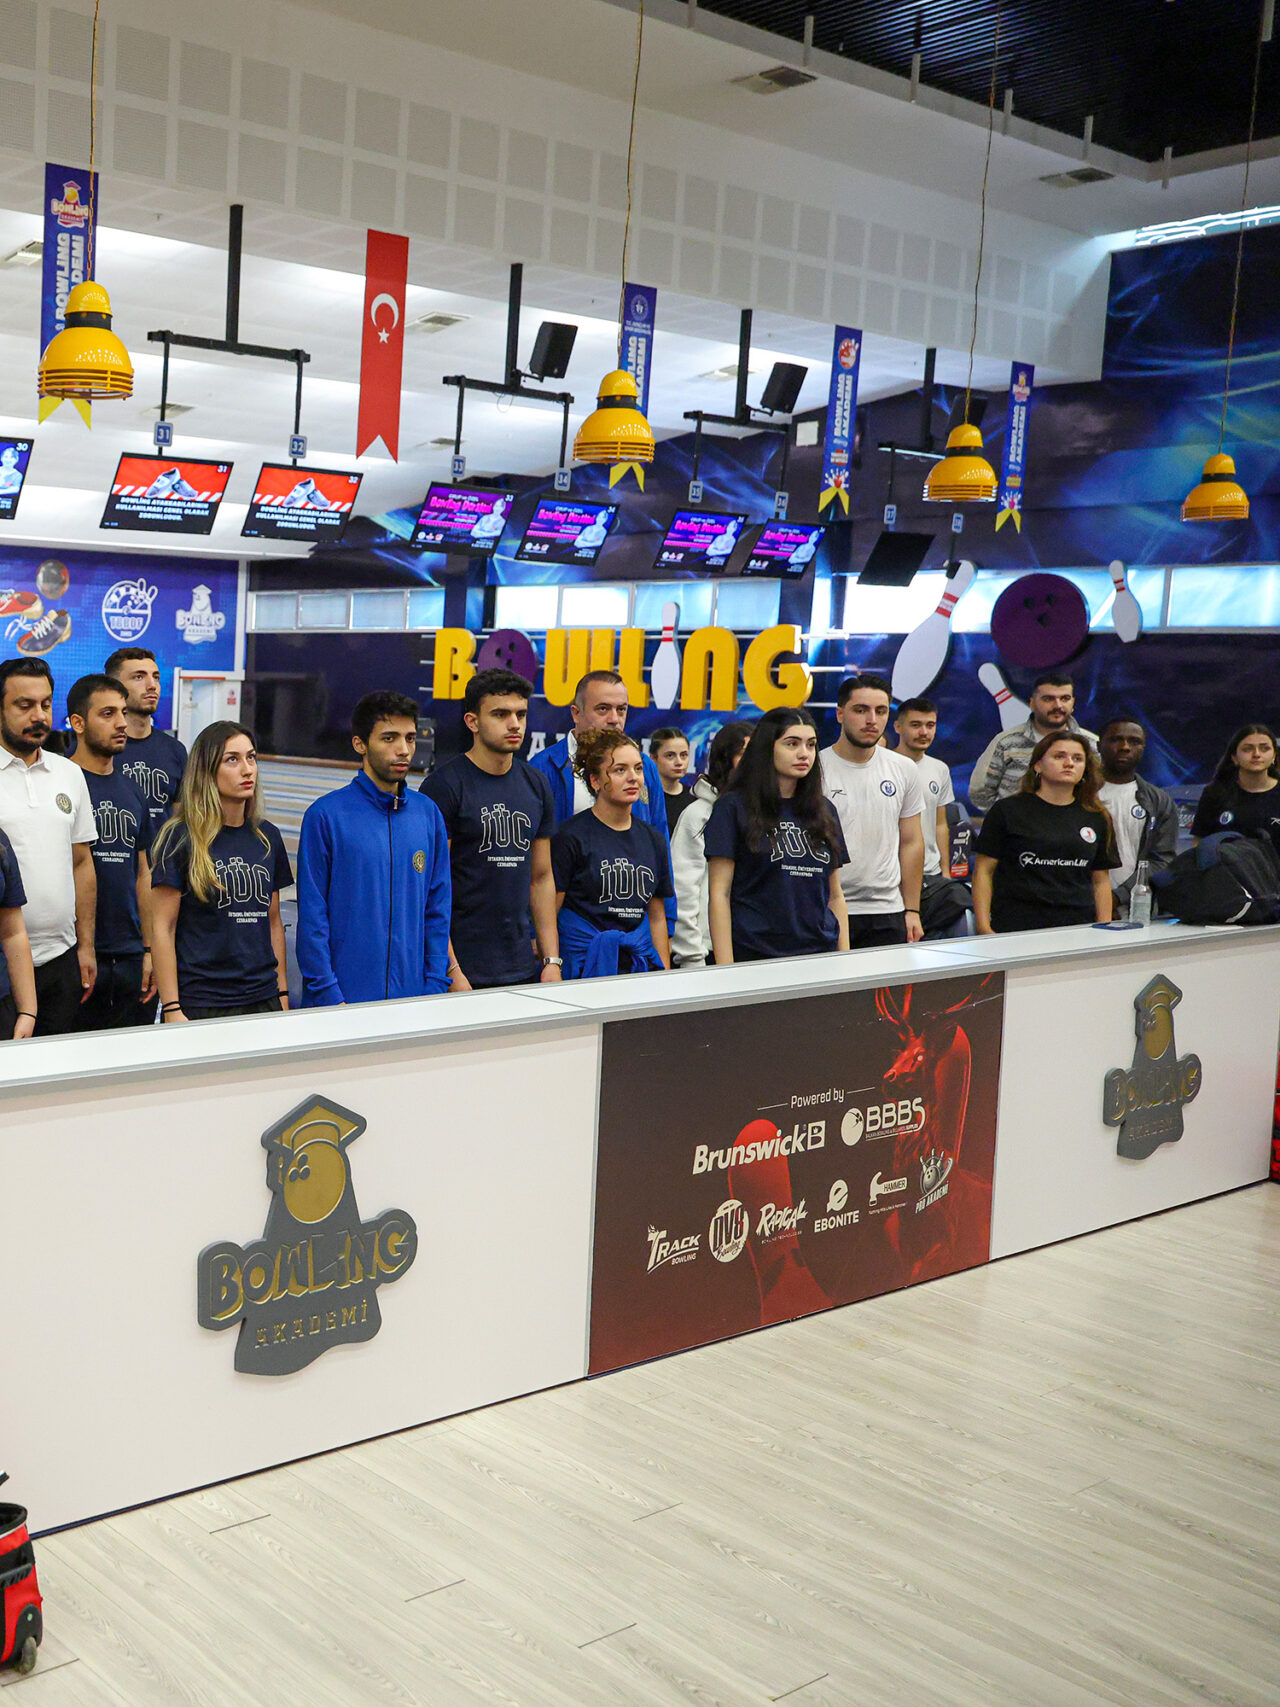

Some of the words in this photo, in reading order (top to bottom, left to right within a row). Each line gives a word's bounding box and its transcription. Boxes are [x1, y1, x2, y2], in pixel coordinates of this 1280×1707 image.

[157, 428, 170, 440] 31
[16, 443, 28, 451] 30
[291, 440, 304, 452] 32
[217, 465, 228, 473] 31
[348, 476, 359, 484] 32
[478, 803, 531, 854] İÜC
[215, 856, 271, 909] İÜC
[599, 858, 654, 904] İÜC
[790, 1091, 832, 1109] Powered
[833, 1088, 845, 1103] by
[866, 1097, 926, 1133] BBBS
[692, 1123, 807, 1176] Brunswick
[883, 1180, 906, 1192] HAMMER
[755, 1198, 809, 1238] RADICAL
[814, 1210, 860, 1233] EBONITE
[646, 1229, 702, 1271] TRACK
[671, 1254, 697, 1266] BOWLING
[210, 1219, 410, 1322] BOWLING
